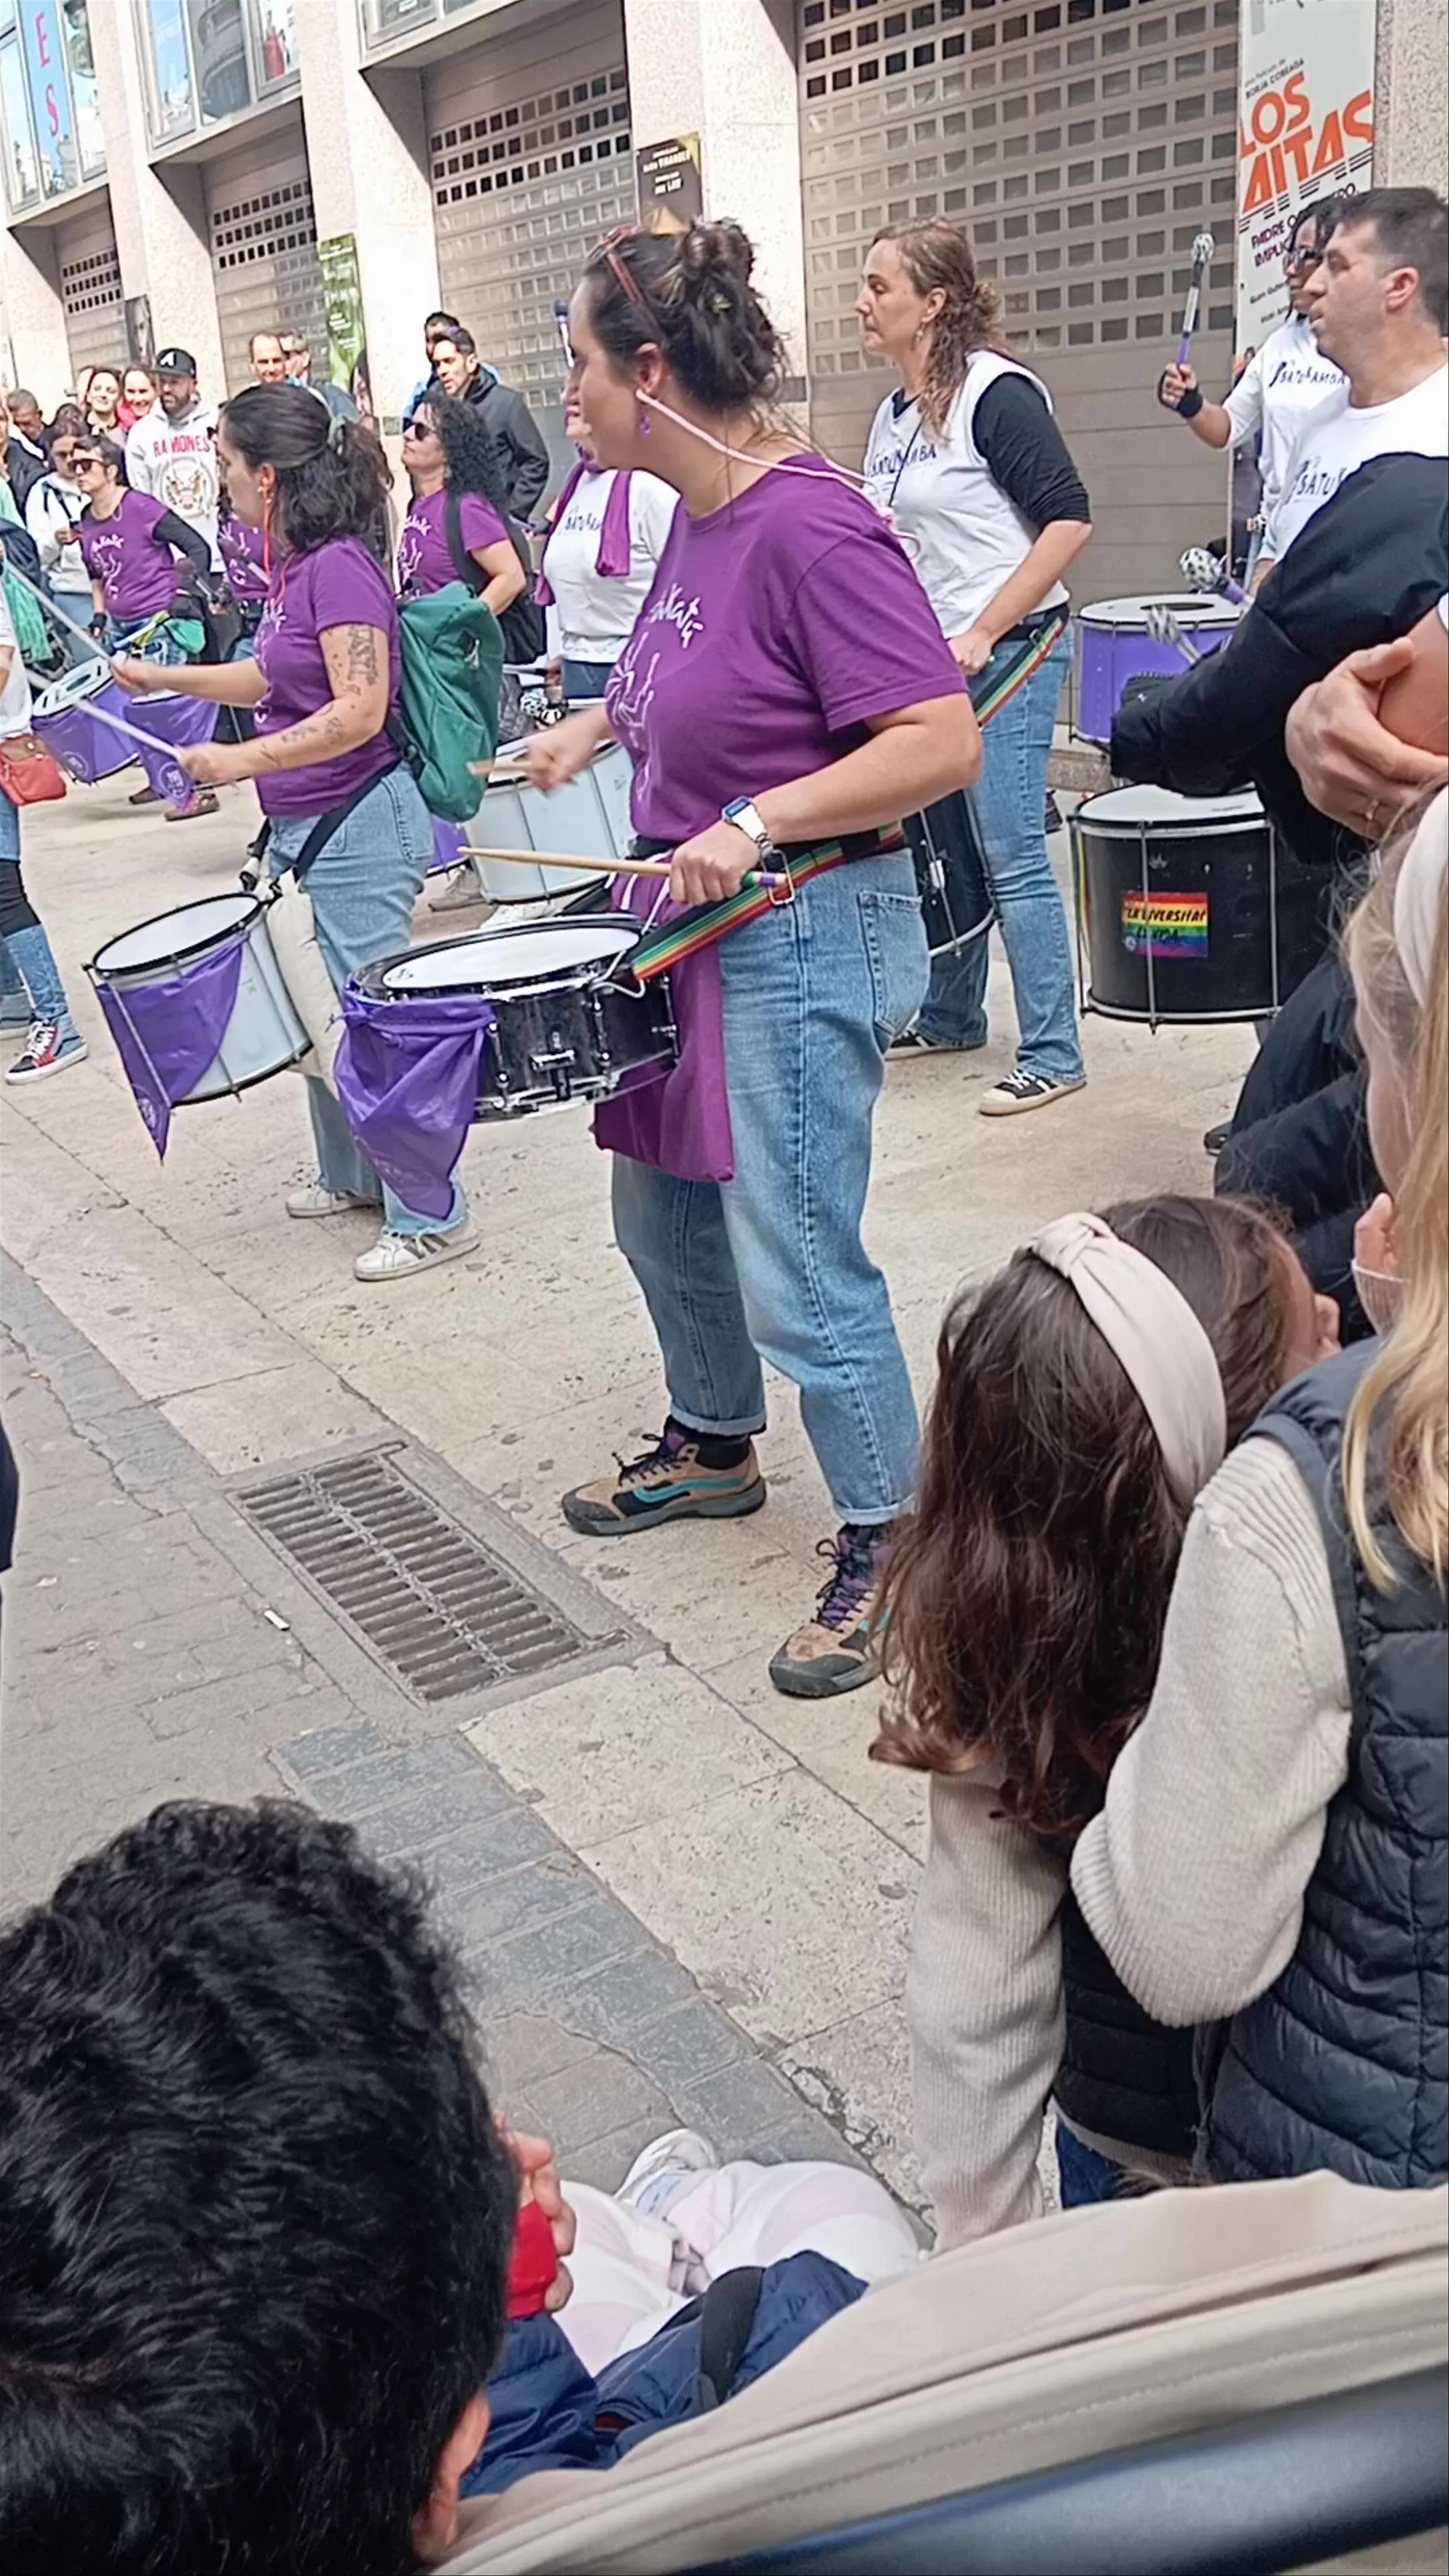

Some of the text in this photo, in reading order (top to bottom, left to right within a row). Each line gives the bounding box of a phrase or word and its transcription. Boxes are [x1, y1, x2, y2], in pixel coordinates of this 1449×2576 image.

[1240, 71, 1310, 158] LOS
[1242, 90, 1373, 214] AITAS
[153, 435, 211, 458] RAMONES
